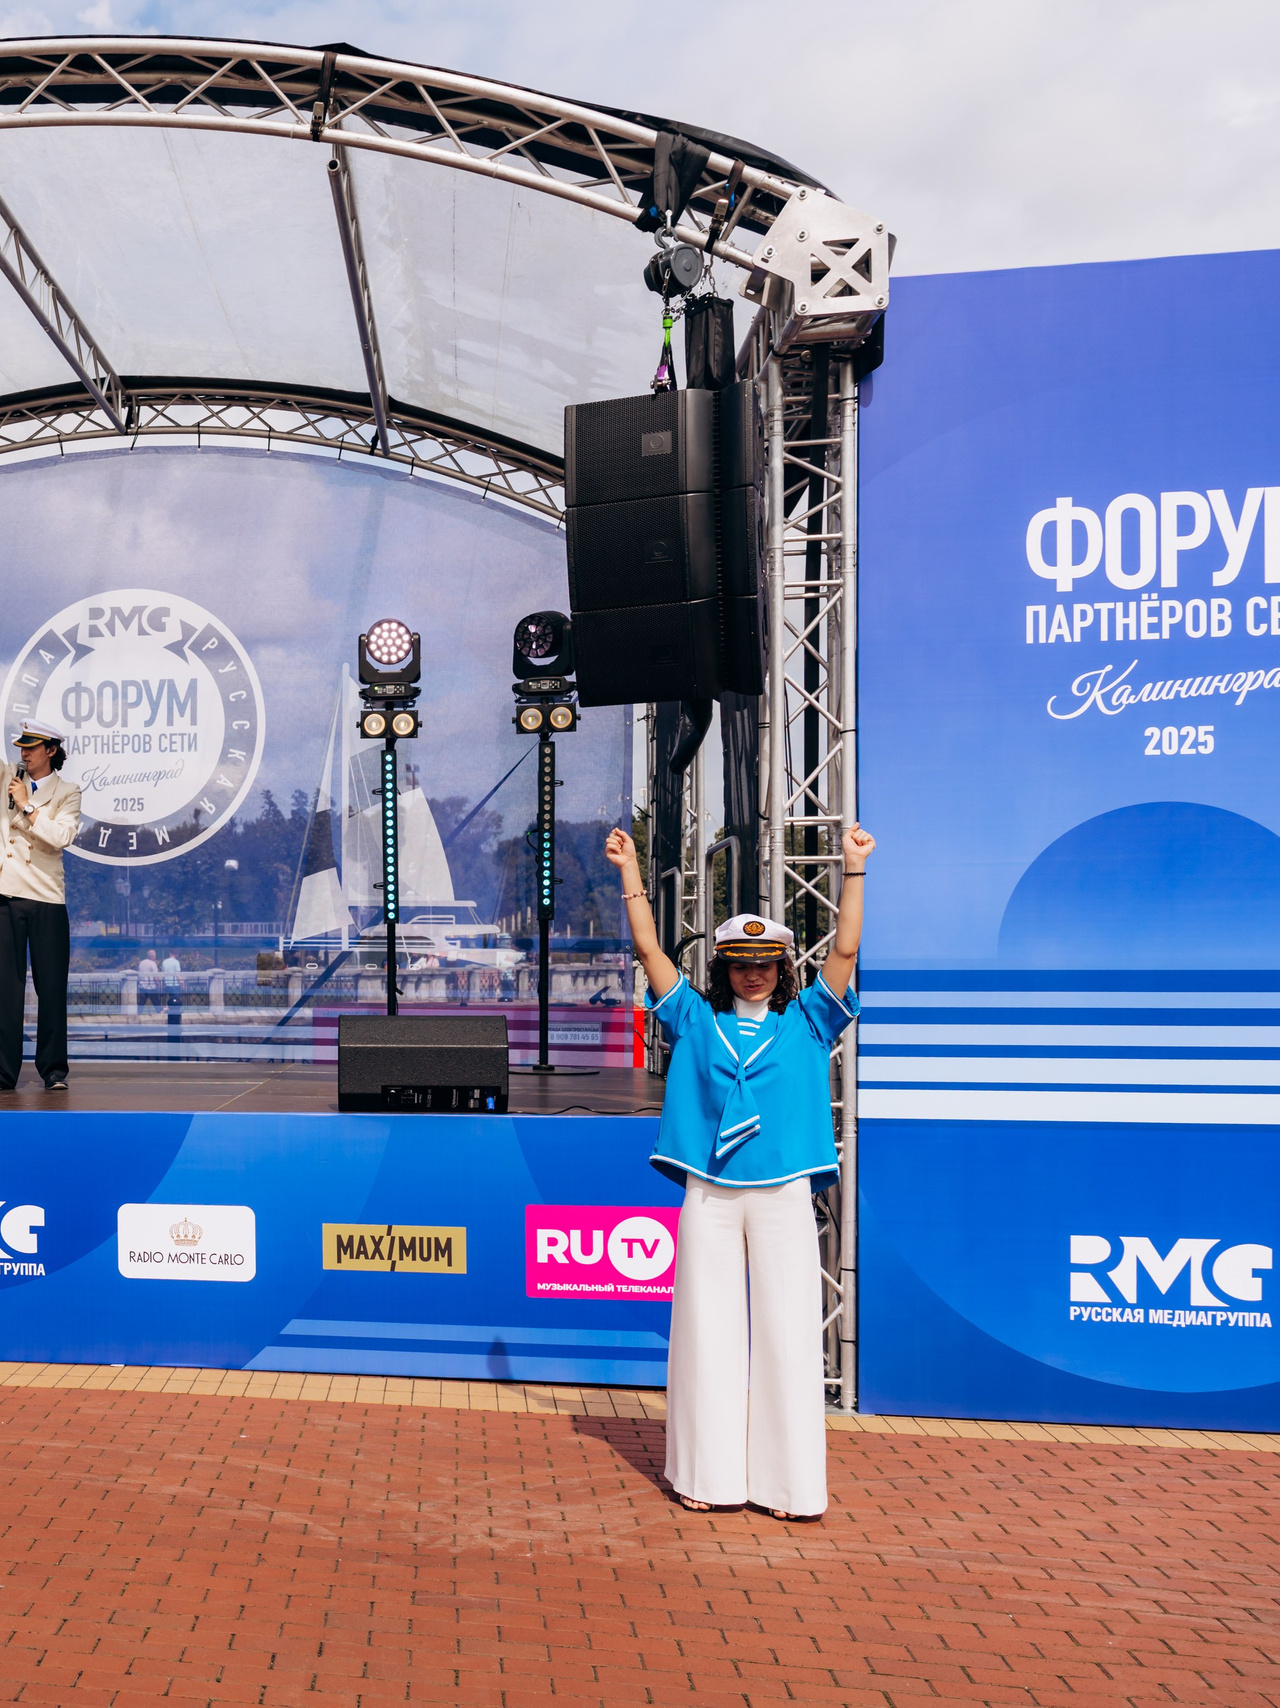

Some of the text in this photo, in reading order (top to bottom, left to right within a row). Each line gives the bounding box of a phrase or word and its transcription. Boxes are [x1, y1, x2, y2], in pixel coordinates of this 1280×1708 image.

[88, 605, 171, 638] RMG
[1026, 593, 1232, 644] ПАРТНЁРОВ
[61, 678, 198, 729] ФОРУМ
[158, 733, 198, 753] СЕТИ
[1143, 725, 1215, 756] 2025
[81, 759, 186, 792] Калининград
[113, 797, 145, 812] 2025
[129, 1250, 245, 1266] RADIO MONTE CARLO
[536, 1228, 661, 1265] RU TV
[1070, 1235, 1273, 1307] RMG
[537, 1282, 674, 1294] МУЗЫКАЛЬНЫЙ ТЕЛЕКАНАЛ
[1070, 1306, 1272, 1328] РУССКАЯ МЕДИАГРУППА
